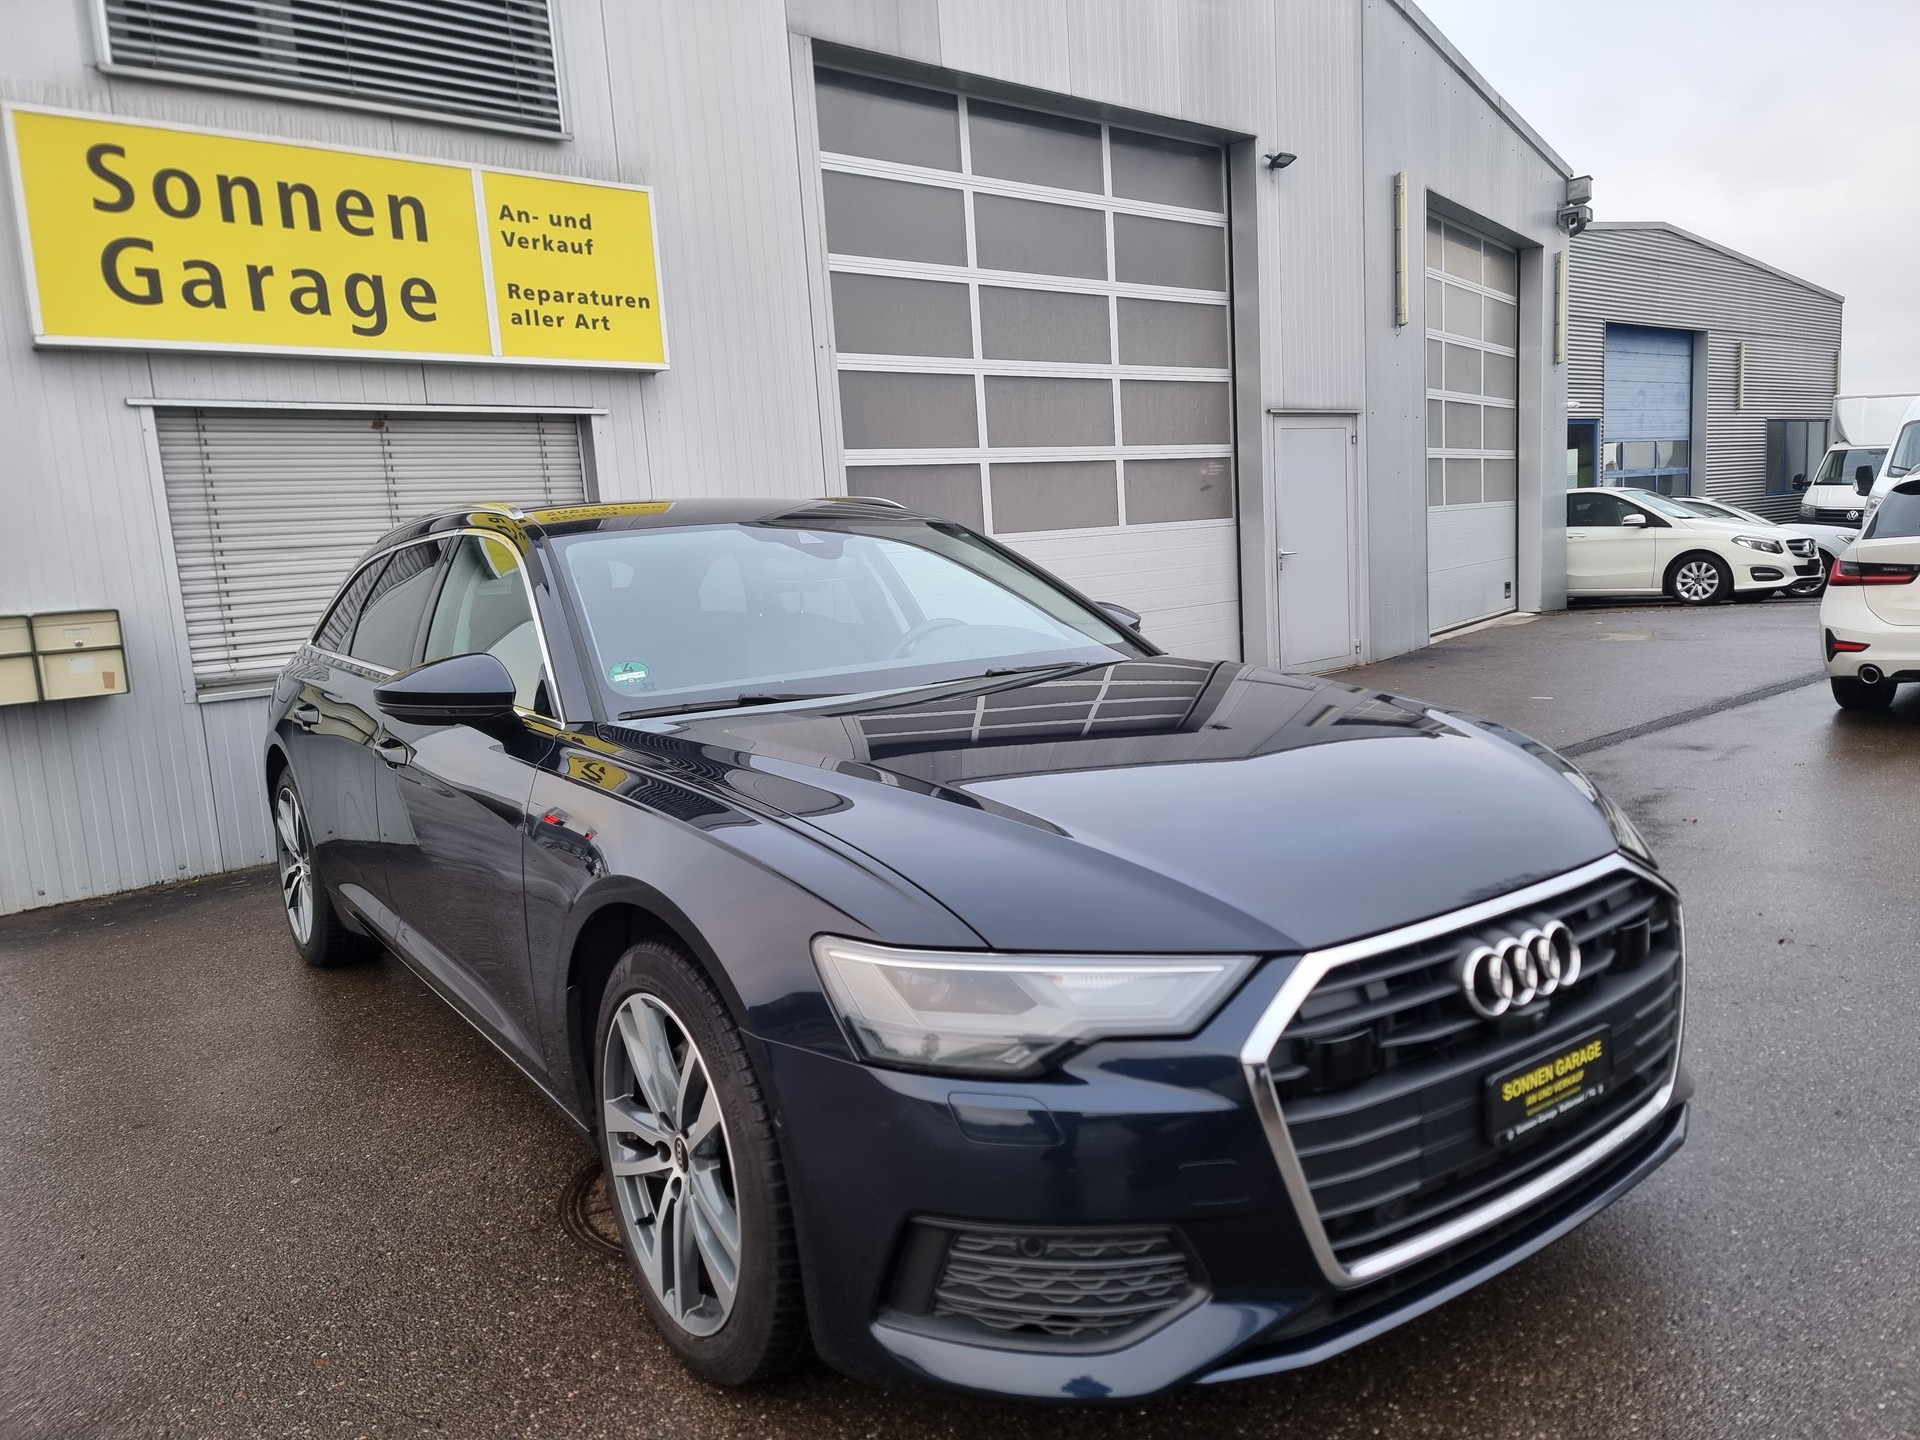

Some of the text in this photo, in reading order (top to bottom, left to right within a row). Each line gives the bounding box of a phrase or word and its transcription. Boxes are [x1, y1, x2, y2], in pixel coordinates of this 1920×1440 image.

[85, 143, 429, 243] Sonnen
[499, 204, 592, 231] An- und
[501, 230, 593, 256] Verkauf
[100, 236, 437, 337] Garage
[507, 283, 651, 309] Reparaturen
[510, 308, 611, 331] aller Art
[1502, 1064, 1554, 1101] SONNEN
[1554, 1040, 1602, 1076] GARAGE
